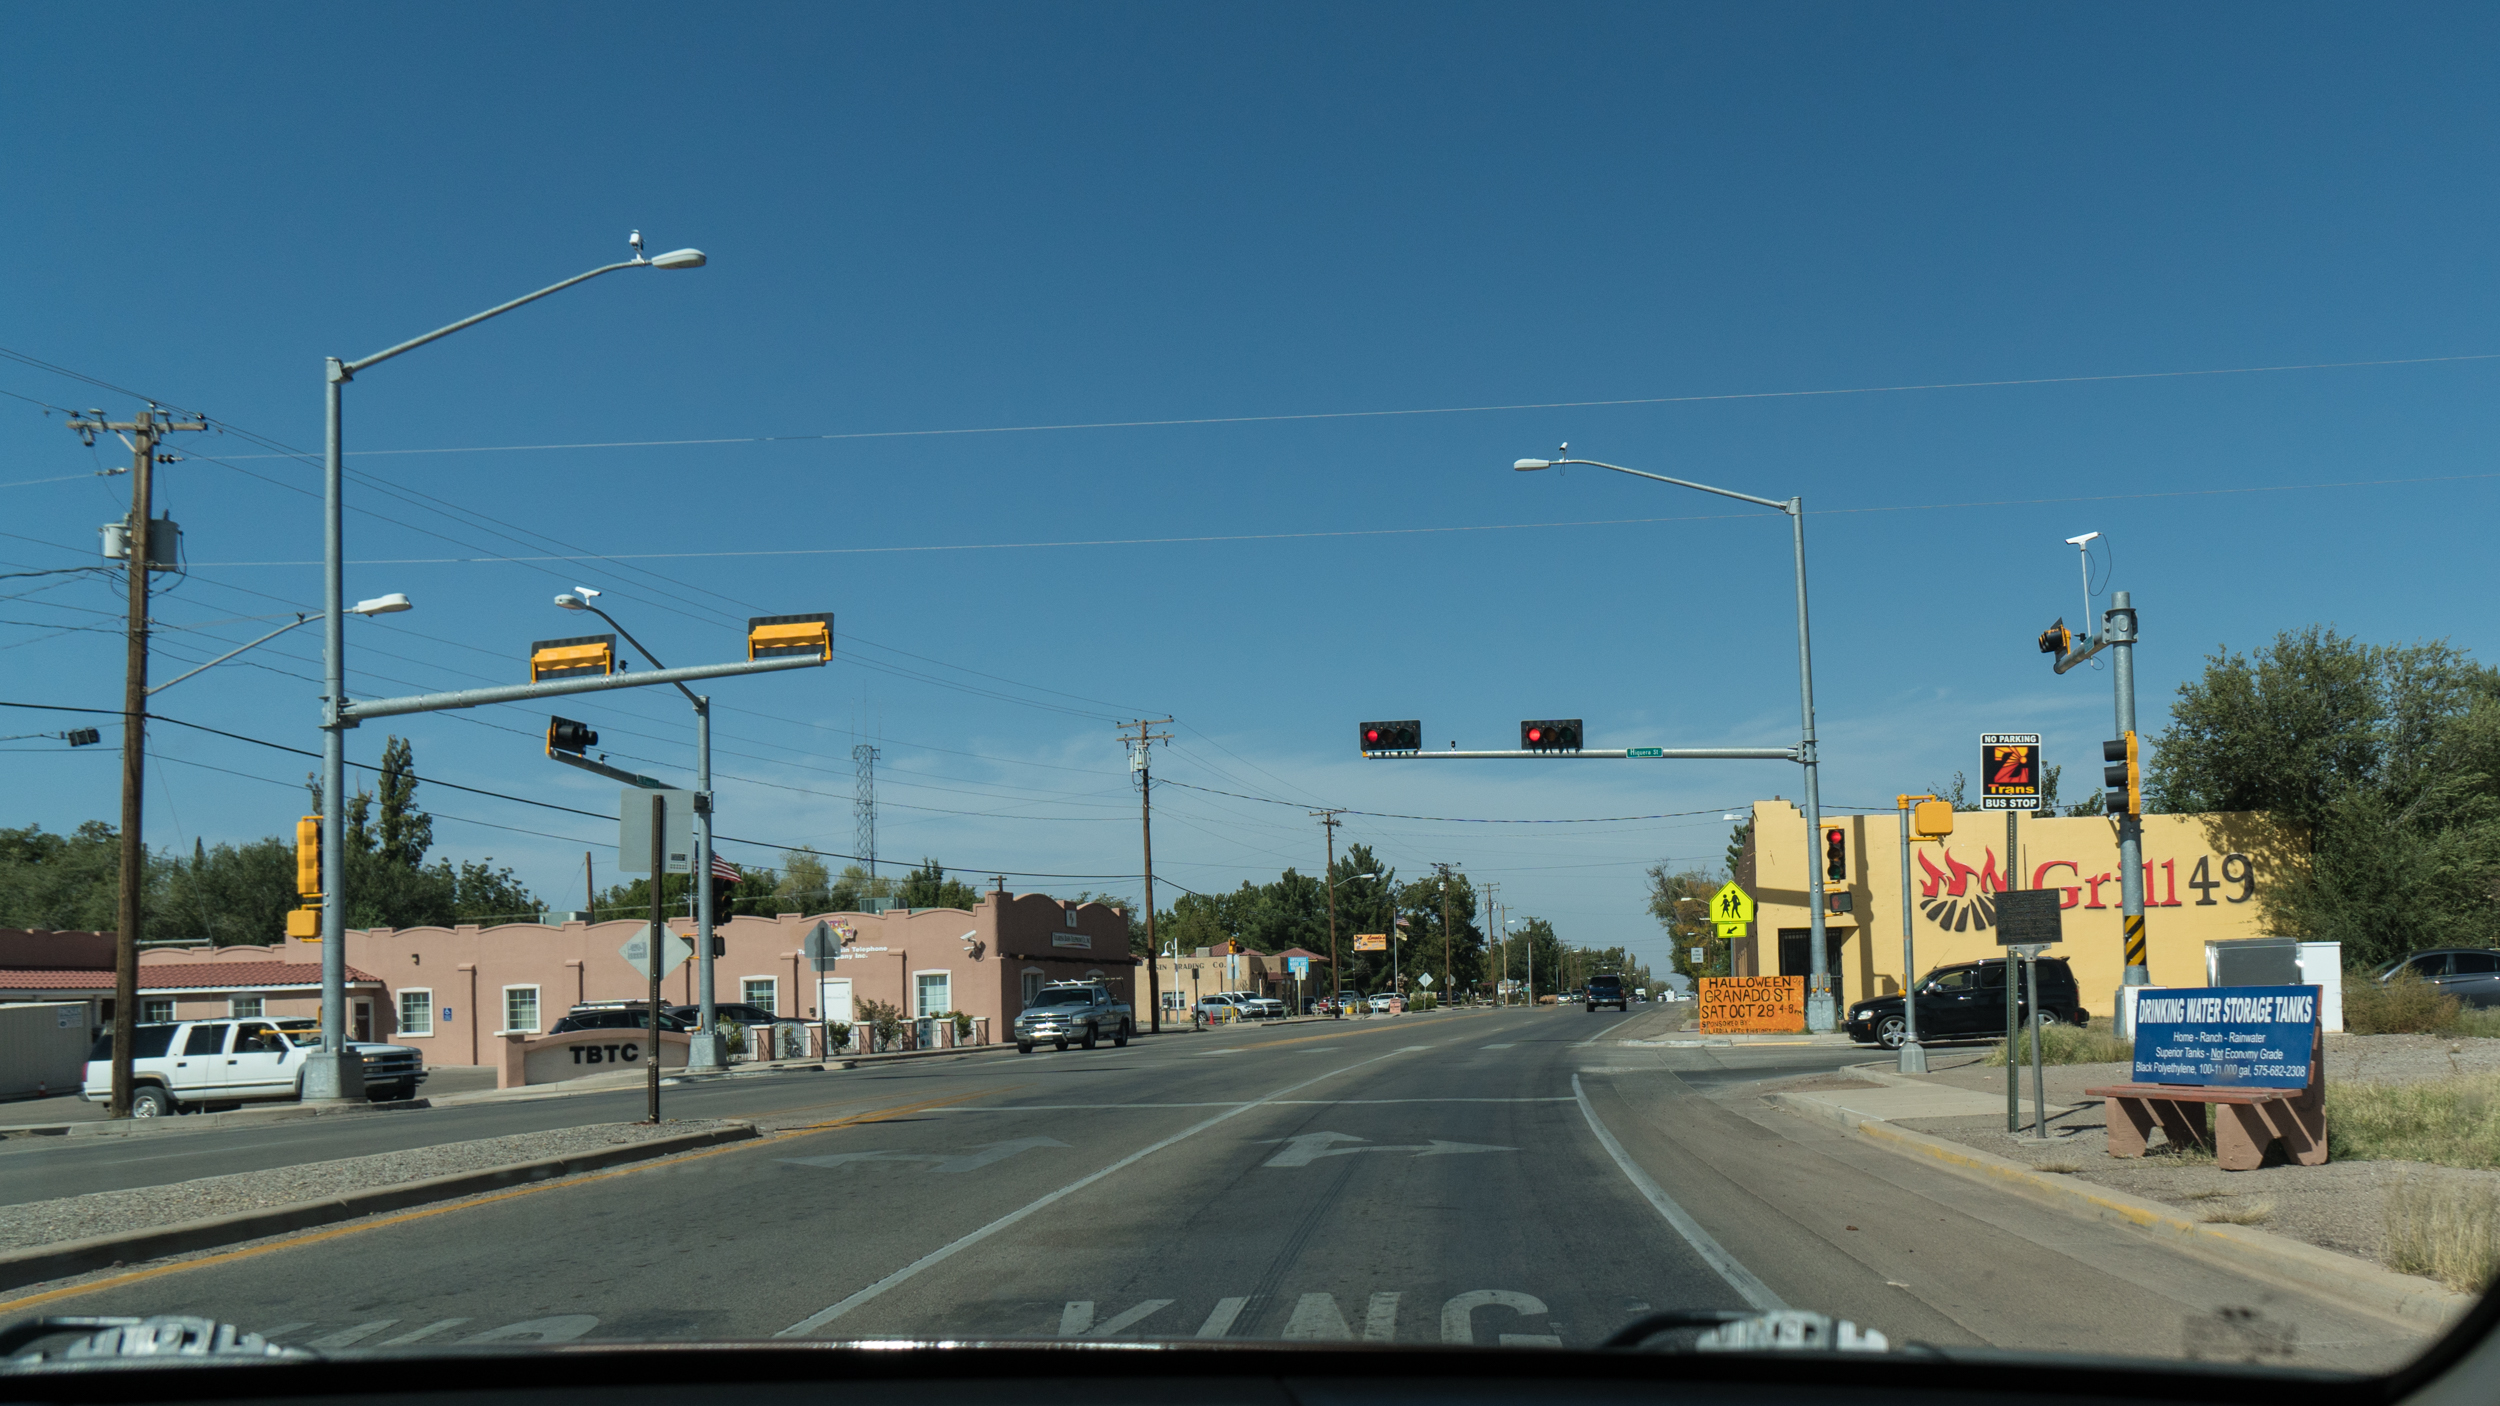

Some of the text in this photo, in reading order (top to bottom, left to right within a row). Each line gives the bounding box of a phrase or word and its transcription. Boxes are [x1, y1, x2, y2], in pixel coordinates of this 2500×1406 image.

[1984, 735, 2037, 743] NO PARKING
[1988, 783, 2035, 794] Trans
[1985, 798, 2037, 808] BUS STOP
[2032, 852, 2255, 910] Grll 49
[1709, 977, 1791, 989] HALLOWEEN
[1704, 988, 1770, 1004] GRANADO
[1729, 1003, 1756, 1019] OCT
[1757, 1003, 1775, 1018] 28
[2138, 996, 2312, 1024] DRINKING WATER STORAGE TANKS
[2173, 1031, 2194, 1042] Home
[2200, 1031, 2223, 1043] Ranch
[2228, 1031, 2266, 1043] Rainwater
[569, 1043, 639, 1064] TBTC
[2155, 1046, 2183, 1060] Superior
[2185, 1047, 2205, 1058] Tanks
[2210, 1048, 2224, 1060] Not
[2225, 1047, 2258, 1062] Economy
[2260, 1048, 2284, 1060] Grade
[2135, 1061, 2153, 1072] Black
[2153, 1062, 2197, 1076] Polyethylene,
[2253, 1064, 2306, 1078] 575-682-2308
